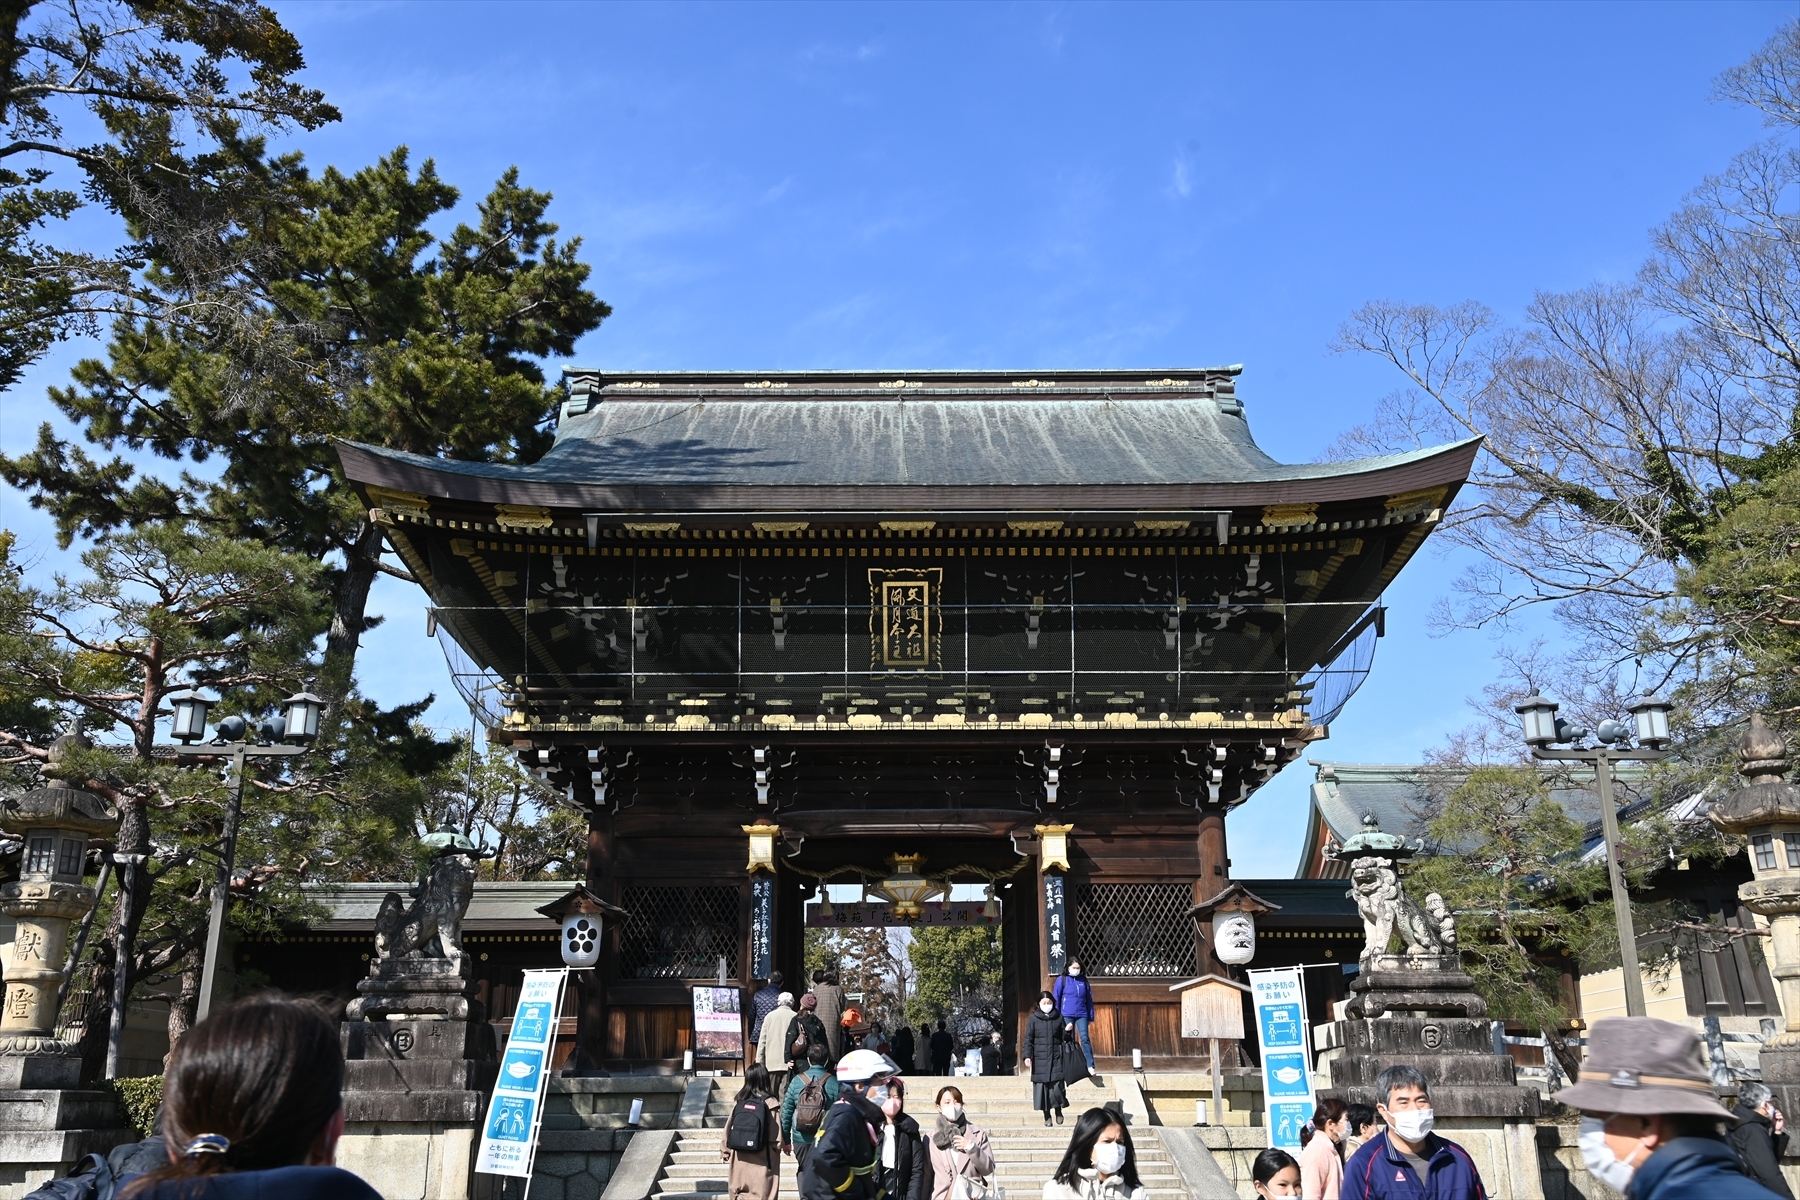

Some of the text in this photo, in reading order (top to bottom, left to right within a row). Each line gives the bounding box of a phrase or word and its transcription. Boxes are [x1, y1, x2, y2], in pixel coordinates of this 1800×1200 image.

[835, 909, 969, 924] 梅苑「花庭」公開
[1050, 913, 1065, 959] 月首祭
[1257, 981, 1296, 991] 感染予防の
[1265, 991, 1291, 1000] お願い
[489, 1143, 522, 1153] ともに祈る
[488, 1152, 520, 1162] 一年の無事
